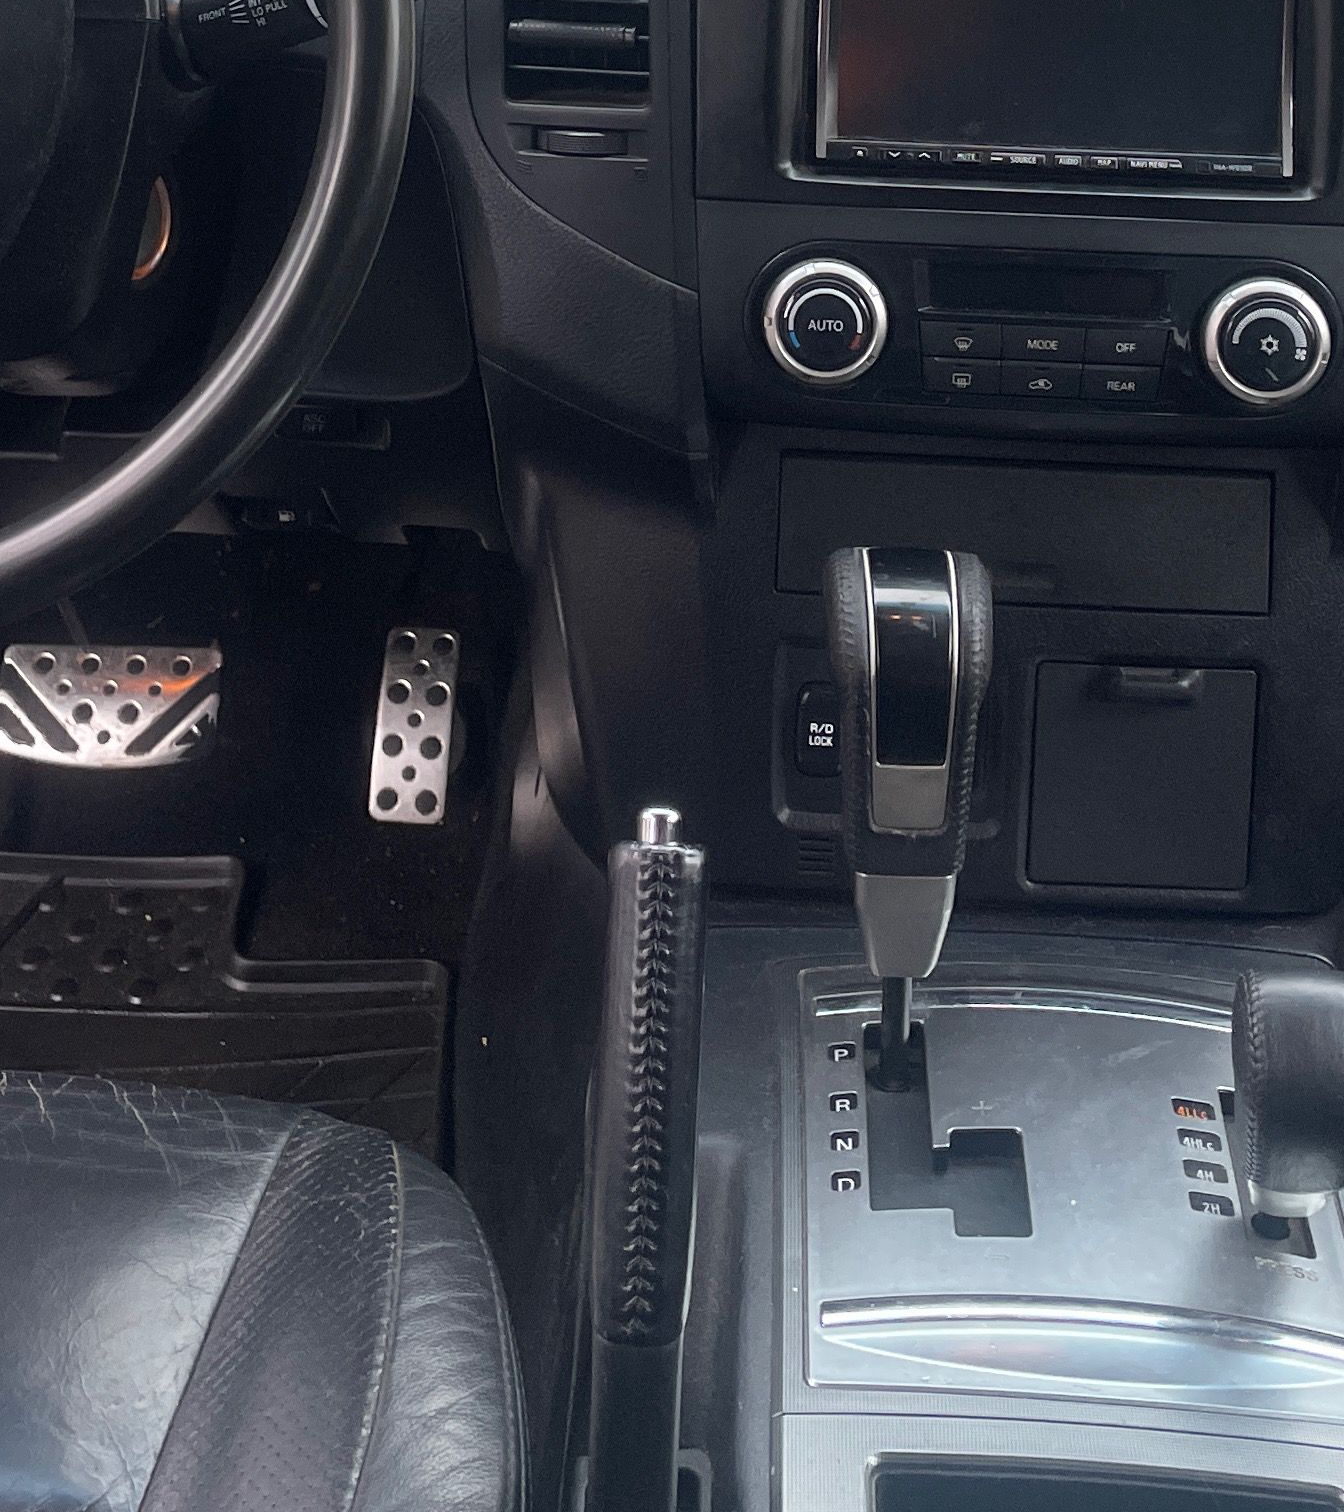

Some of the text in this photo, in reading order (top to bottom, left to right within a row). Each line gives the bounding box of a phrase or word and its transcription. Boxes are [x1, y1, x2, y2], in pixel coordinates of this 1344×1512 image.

[265, 0, 288, 13] PULL
[198, 7, 226, 24] FRONT
[1009, 156, 1037, 164] SOURCE
[1058, 156, 1080, 165] AUDIO
[807, 319, 844, 332] AUTO
[1026, 338, 1059, 351] MODE
[1115, 341, 1137, 354] OFF
[1107, 380, 1136, 392] REAR
[809, 722, 834, 734] R/D
[808, 735, 833, 747] LOCK
[833, 1048, 849, 1062] P
[835, 1099, 851, 1112] R
[836, 1137, 853, 1151] N
[1196, 1169, 1214, 1183] 4H
[837, 1178, 855, 1192] D
[1201, 1201, 1220, 1215] 2H
